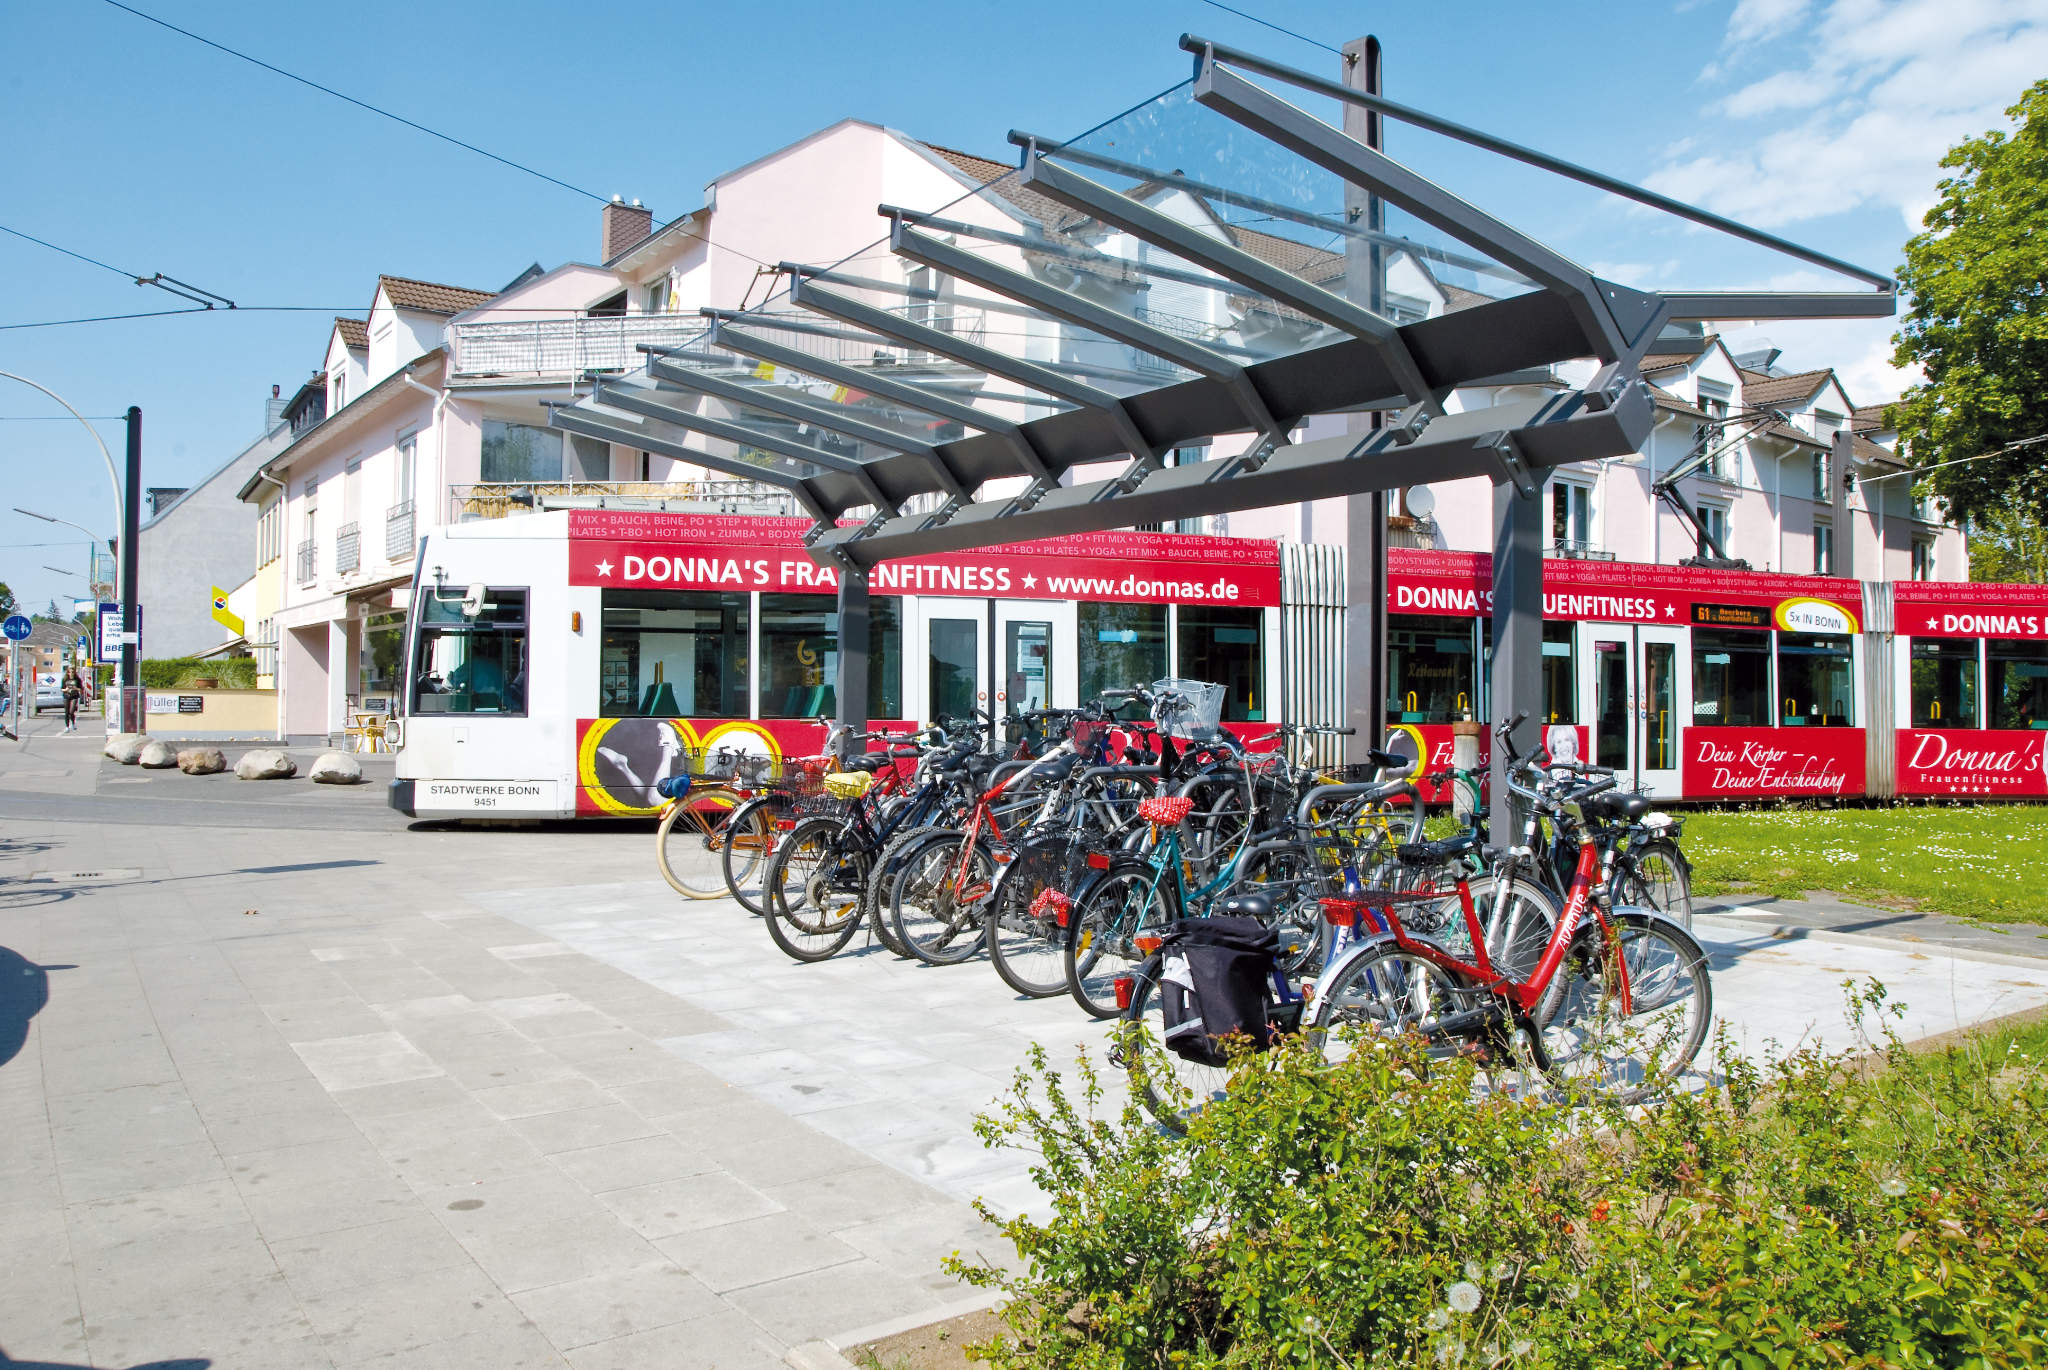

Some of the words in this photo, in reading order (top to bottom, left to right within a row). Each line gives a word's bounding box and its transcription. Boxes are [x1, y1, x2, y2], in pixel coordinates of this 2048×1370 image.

[577, 515, 599, 525] MIX
[610, 516, 651, 526] BAUCH,
[654, 516, 687, 526] BEINE,
[690, 517, 705, 525] PO
[716, 517, 741, 526] STEP
[619, 528, 644, 537] T-BO
[655, 528, 677, 537] HOT
[680, 529, 707, 538] IRON
[718, 529, 757, 538] ZUMBA
[1093, 534, 1106, 543] FIT
[1109, 535, 1126, 544] MIX
[1136, 536, 1163, 545] YOGA
[1172, 537, 1205, 546] PILATES
[1215, 538, 1234, 546] T-BO
[1243, 538, 1260, 547] HOT
[1012, 546, 1034, 554] T-BO
[1044, 546, 1079, 555] PILATES
[1089, 547, 1117, 556] YOGA
[1126, 548, 1140, 556] FIT
[1142, 549, 1159, 557] MIX
[1168, 550, 1202, 559] BAUCH,
[1204, 550, 1231, 559] BEINE,
[1254, 551, 1274, 559] STEP
[1447, 559, 1474, 567] ZUMBA
[1543, 562, 1569, 570] PILATES
[1576, 563, 1596, 571] YOGA
[624, 556, 769, 584] DONNA'S
[1047, 574, 1239, 600] www.donnas.de
[1576, 573, 1596, 581] YOGA
[1542, 593, 1656, 619] UENFITNESS
[1698, 607, 1710, 621] 61
[1789, 611, 1800, 623] 5x
[1803, 613, 1812, 625] IN
[1815, 615, 1841, 629] BONN
[1943, 614, 2039, 635] DONNA'S
[1697, 741, 1737, 763] Dein
[1739, 741, 1788, 772] Körper
[1908, 733, 2041, 772] Donna's
[1712, 767, 1759, 789] Deine
[1760, 756, 1846, 794] Entscheidung
[1920, 773, 2023, 784] Frauenfitness
[430, 785, 505, 795] STADTWERKE
[508, 786, 540, 795] BONN
[474, 798, 497, 807] 9451
